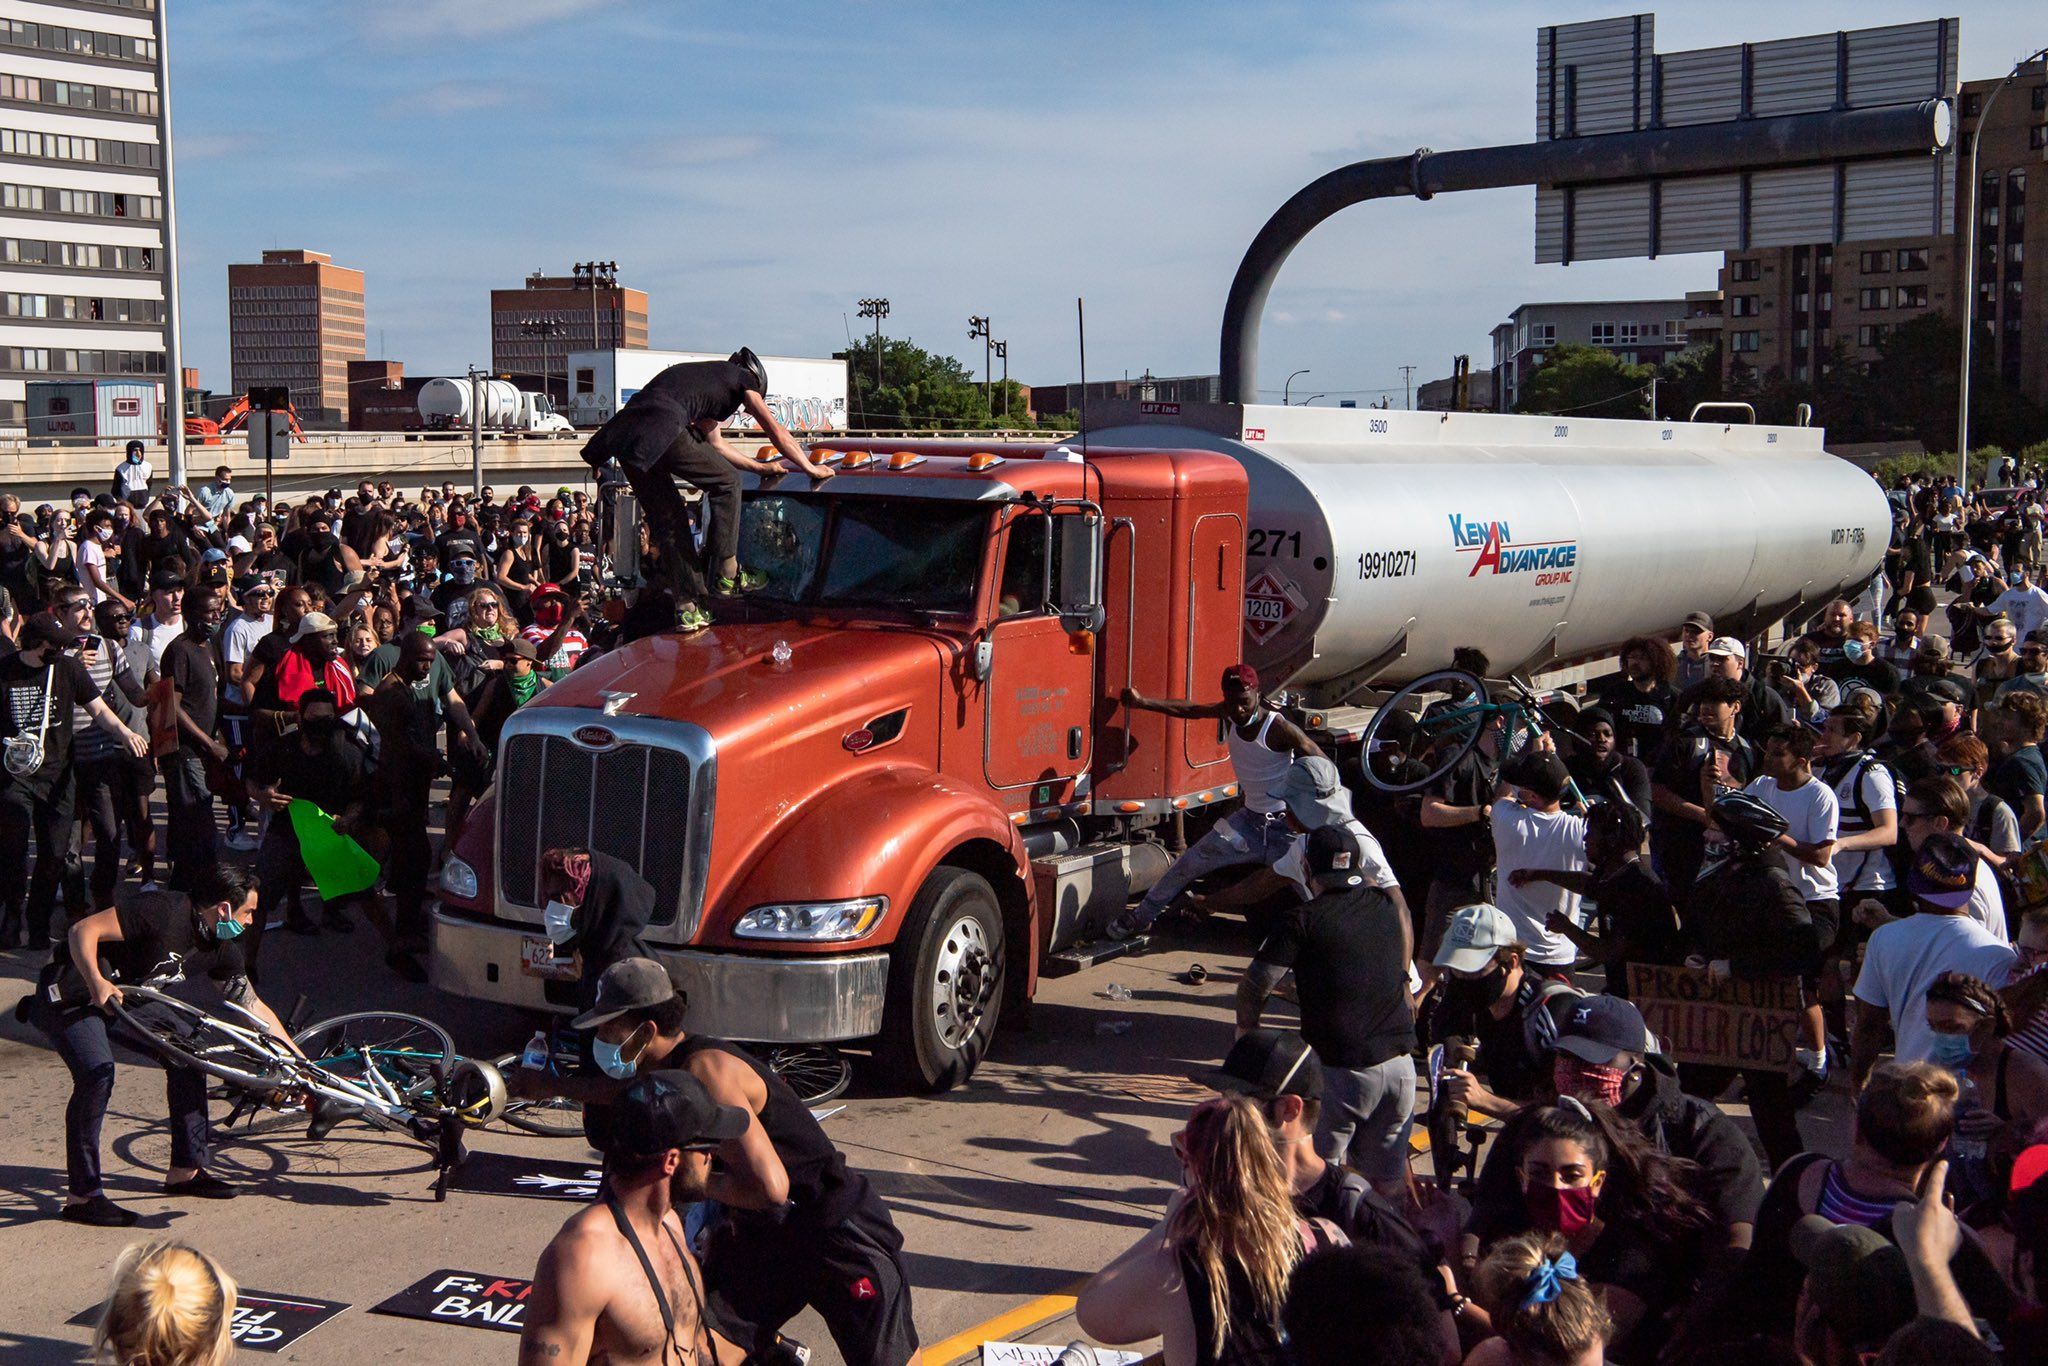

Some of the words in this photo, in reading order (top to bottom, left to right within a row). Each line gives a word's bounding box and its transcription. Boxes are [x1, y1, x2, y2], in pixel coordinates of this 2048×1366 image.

[1369, 419, 1388, 433] 3500
[1554, 425, 1569, 437] 2000
[1448, 513, 1511, 548] KENAN
[1468, 522, 1577, 577] ADVANTAGE
[1358, 550, 1417, 580] 19910271
[1246, 600, 1282, 618] 1203
[1259, 621, 1266, 630] 3
